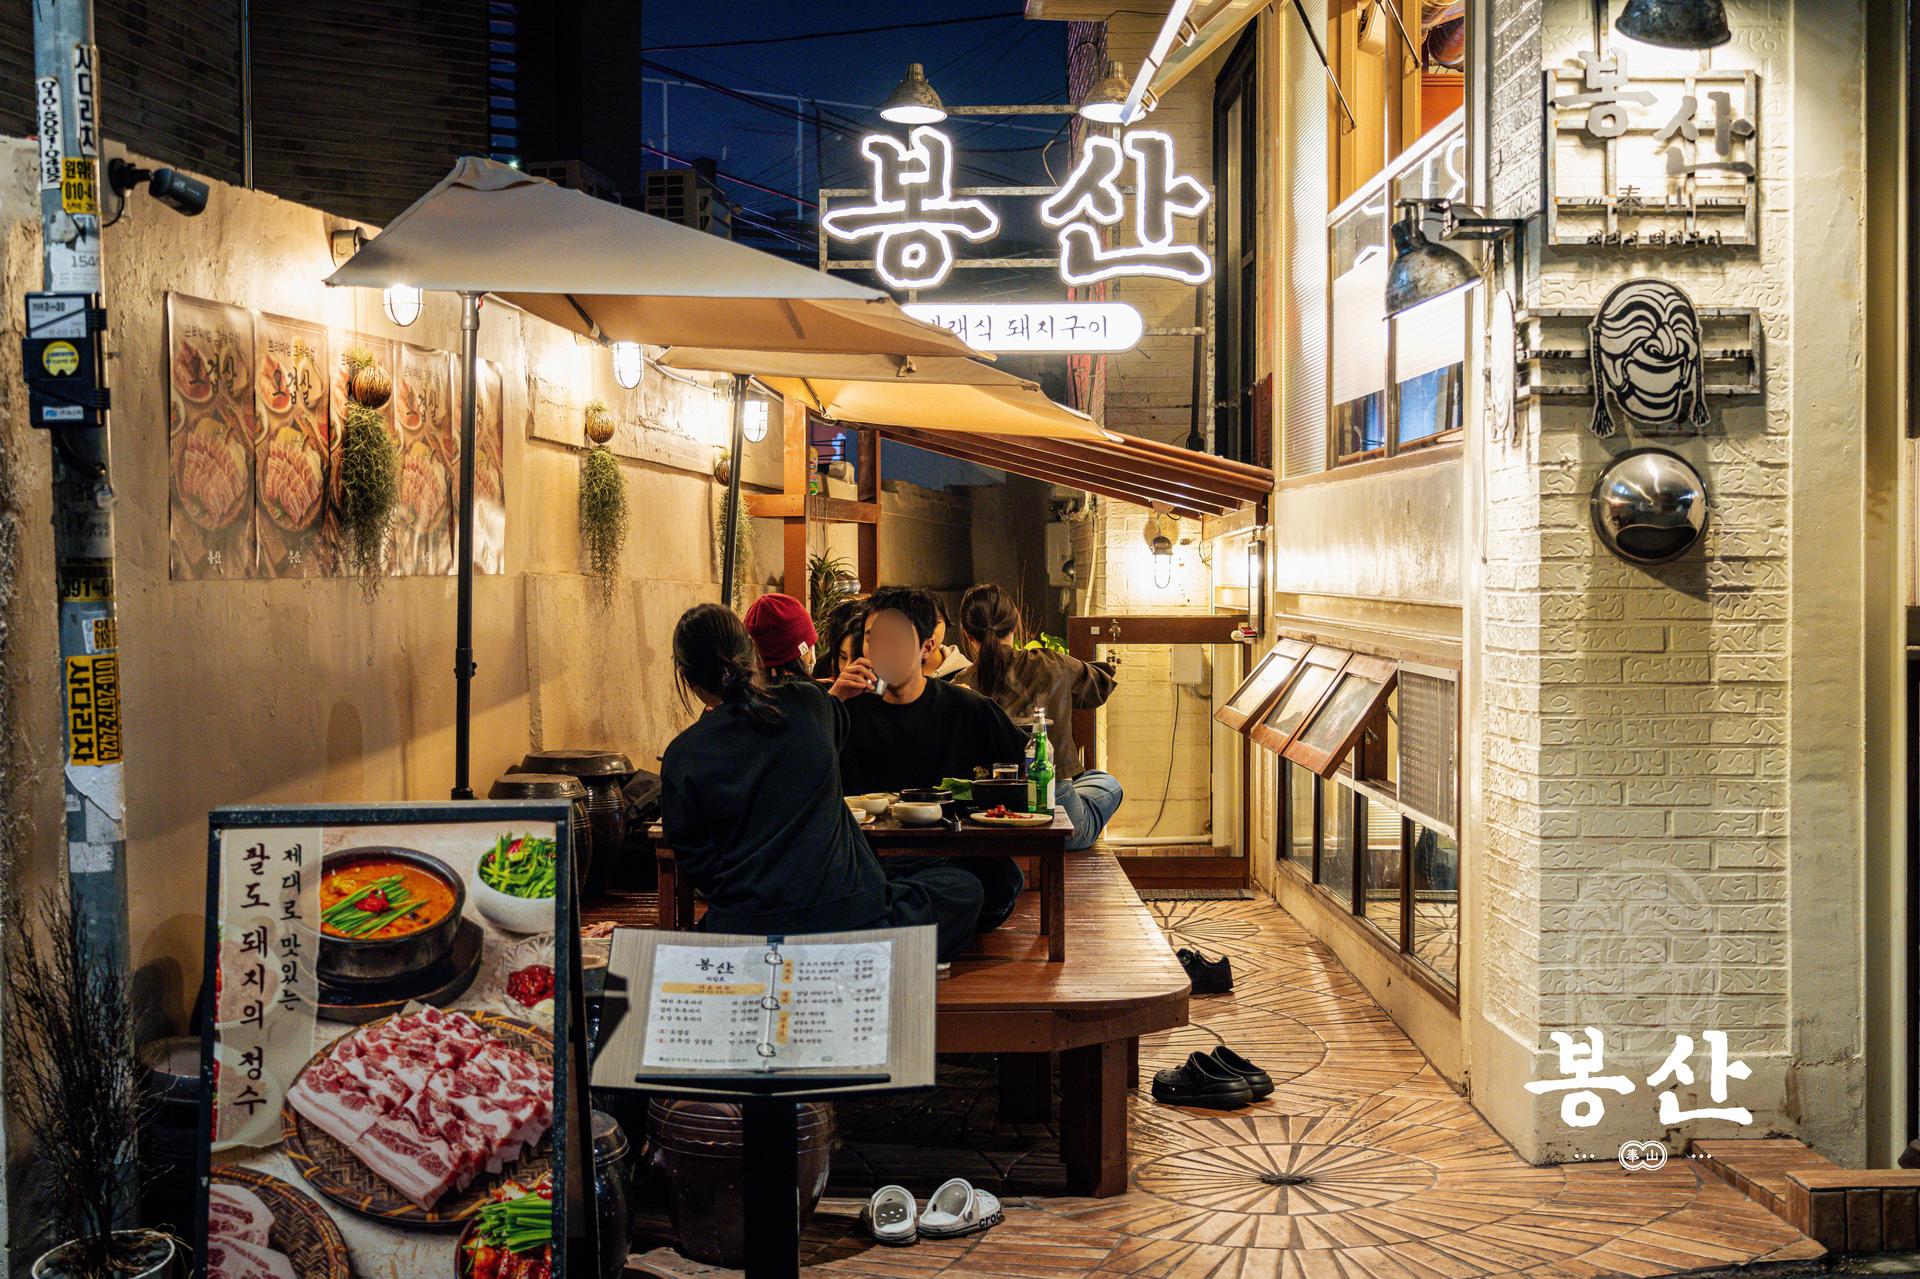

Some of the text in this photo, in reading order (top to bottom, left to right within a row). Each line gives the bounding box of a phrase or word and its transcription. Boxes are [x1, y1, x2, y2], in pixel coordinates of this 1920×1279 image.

[1550, 47, 1755, 177] 봉산
[822, 126, 1212, 288] 봉산
[1006, 313, 1108, 342] 돼지구이
[69, 661, 94, 762] 사다리차
[95, 659, 118, 760] 010-2672-2424
[233, 842, 271, 1116] 팔도 돼지의 정수
[277, 843, 303, 1012] 제대로 맛있는
[695, 957, 735, 975] 봉산
